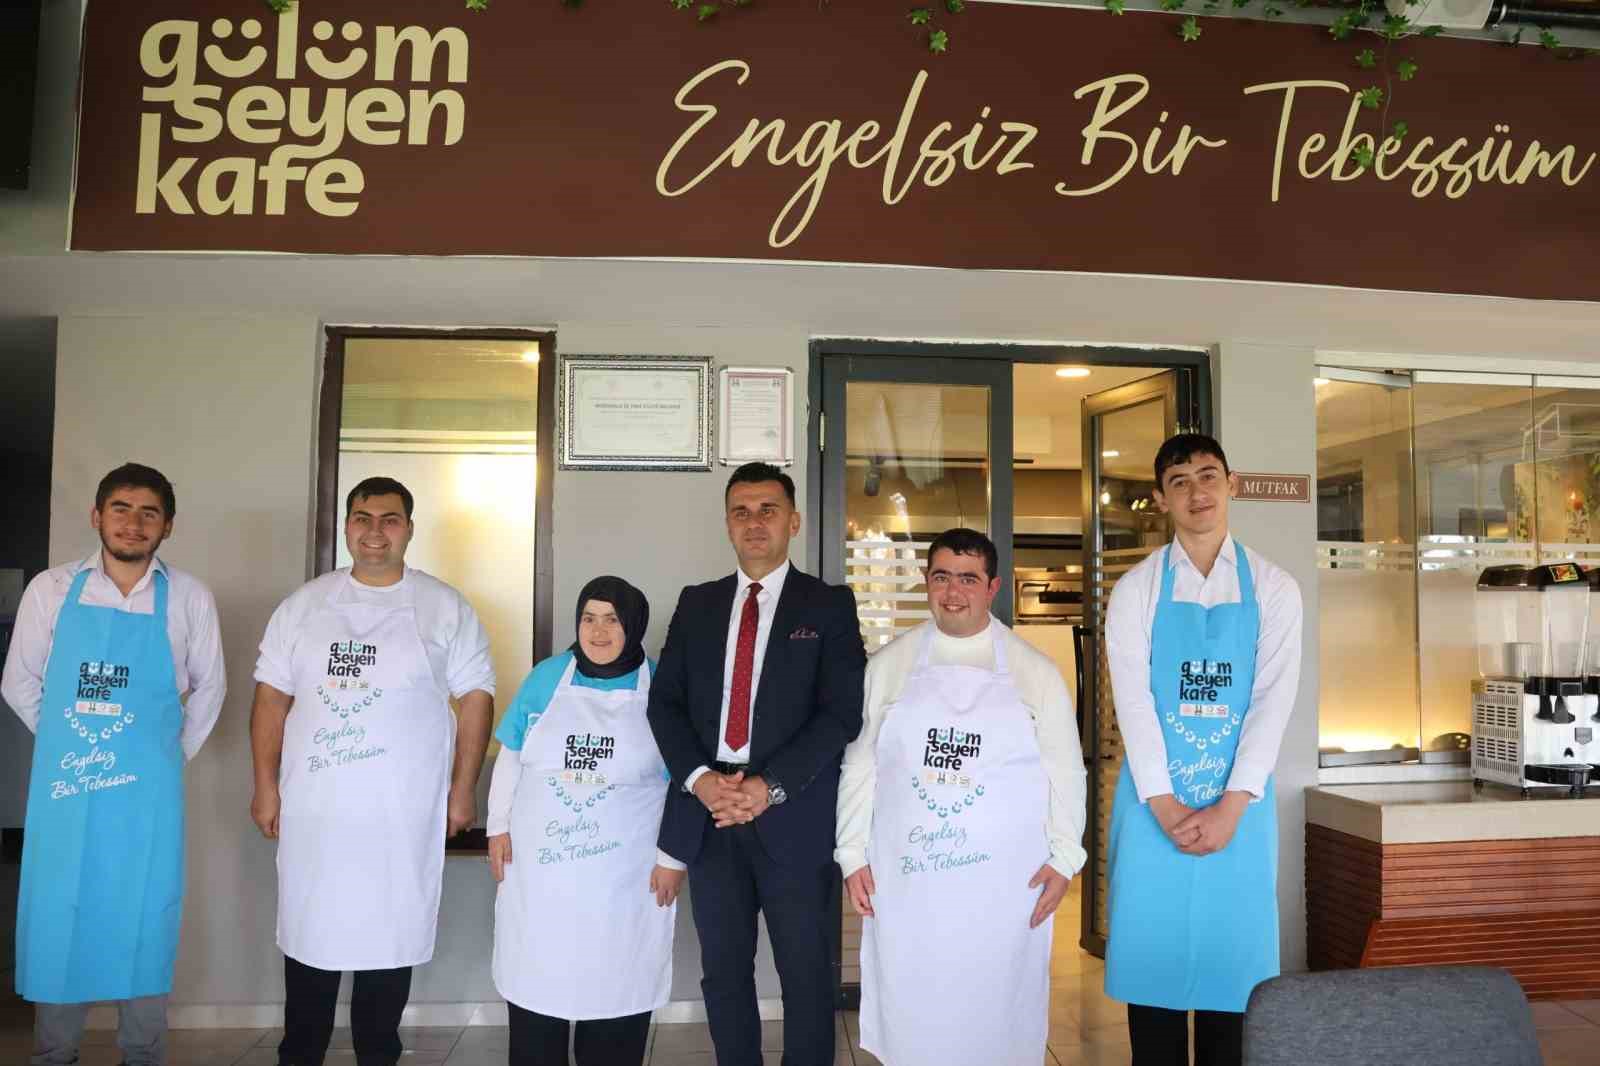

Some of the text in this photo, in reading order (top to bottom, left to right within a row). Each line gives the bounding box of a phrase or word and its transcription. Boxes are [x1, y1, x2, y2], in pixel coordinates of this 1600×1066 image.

[139, 0, 469, 101] gülüm
[171, 84, 465, 158] seyen
[656, 59, 1596, 248] Engelsiz Bir Tebessüm
[135, 113, 365, 217] kafe
[1243, 480, 1299, 496] MUTFAK
[327, 658, 362, 677] kafe
[334, 652, 376, 667] seyen
[76, 679, 113, 700] kafe
[83, 674, 129, 690] seyen
[1179, 678, 1218, 702] kafe
[1185, 674, 1232, 690] seyen
[570, 746, 614, 760] seyen
[923, 746, 963, 771] kafe
[931, 740, 980, 759] seyen
[564, 752, 598, 771] kafe
